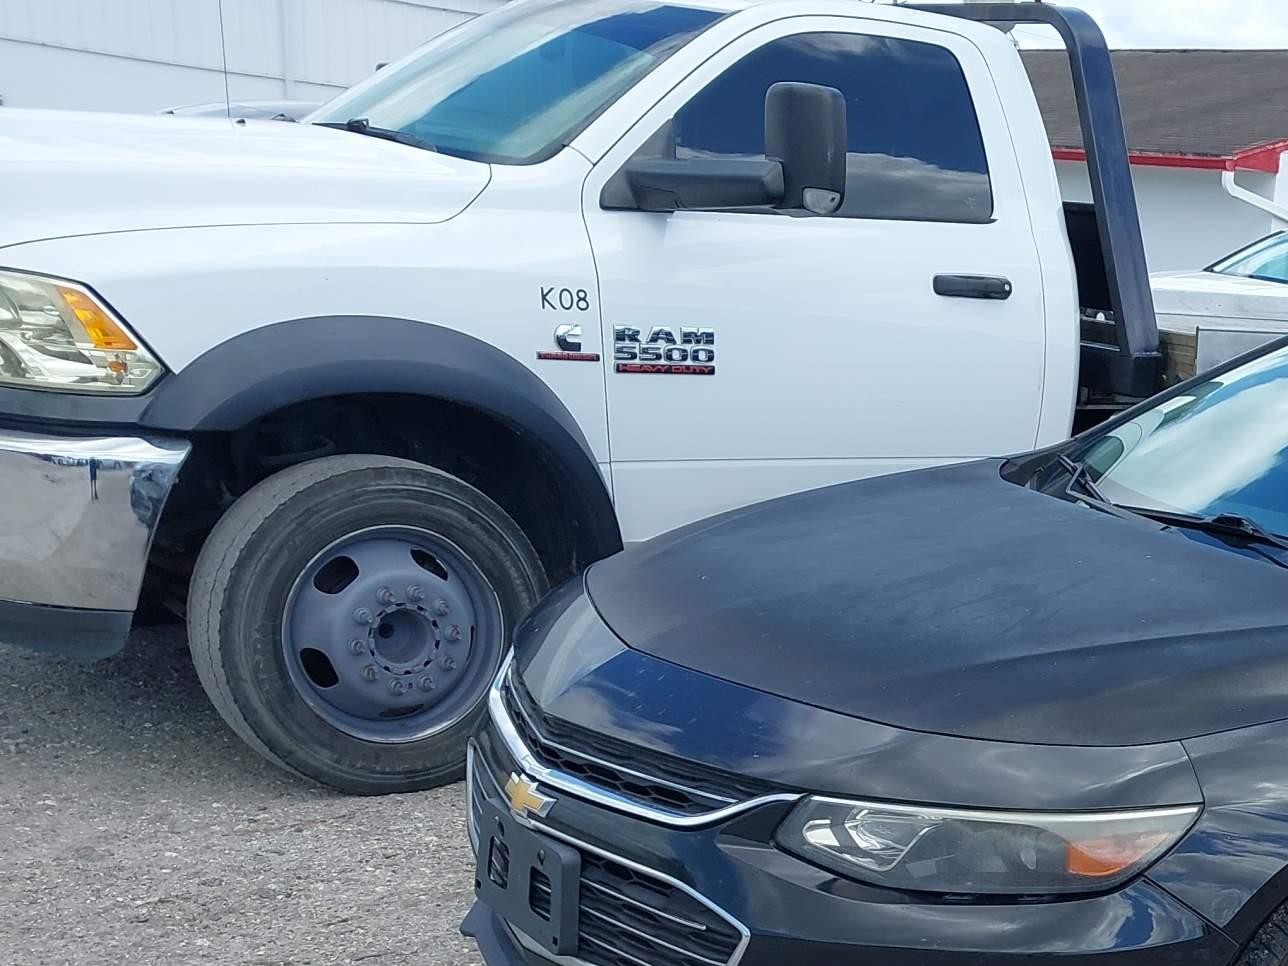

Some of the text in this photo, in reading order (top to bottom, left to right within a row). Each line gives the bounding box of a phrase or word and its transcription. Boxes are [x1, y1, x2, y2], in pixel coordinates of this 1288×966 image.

[540, 287, 590, 311] K08
[613, 324, 715, 345] RAM
[613, 344, 715, 363] 5500
[619, 363, 713, 374] HEAVY DUTY
